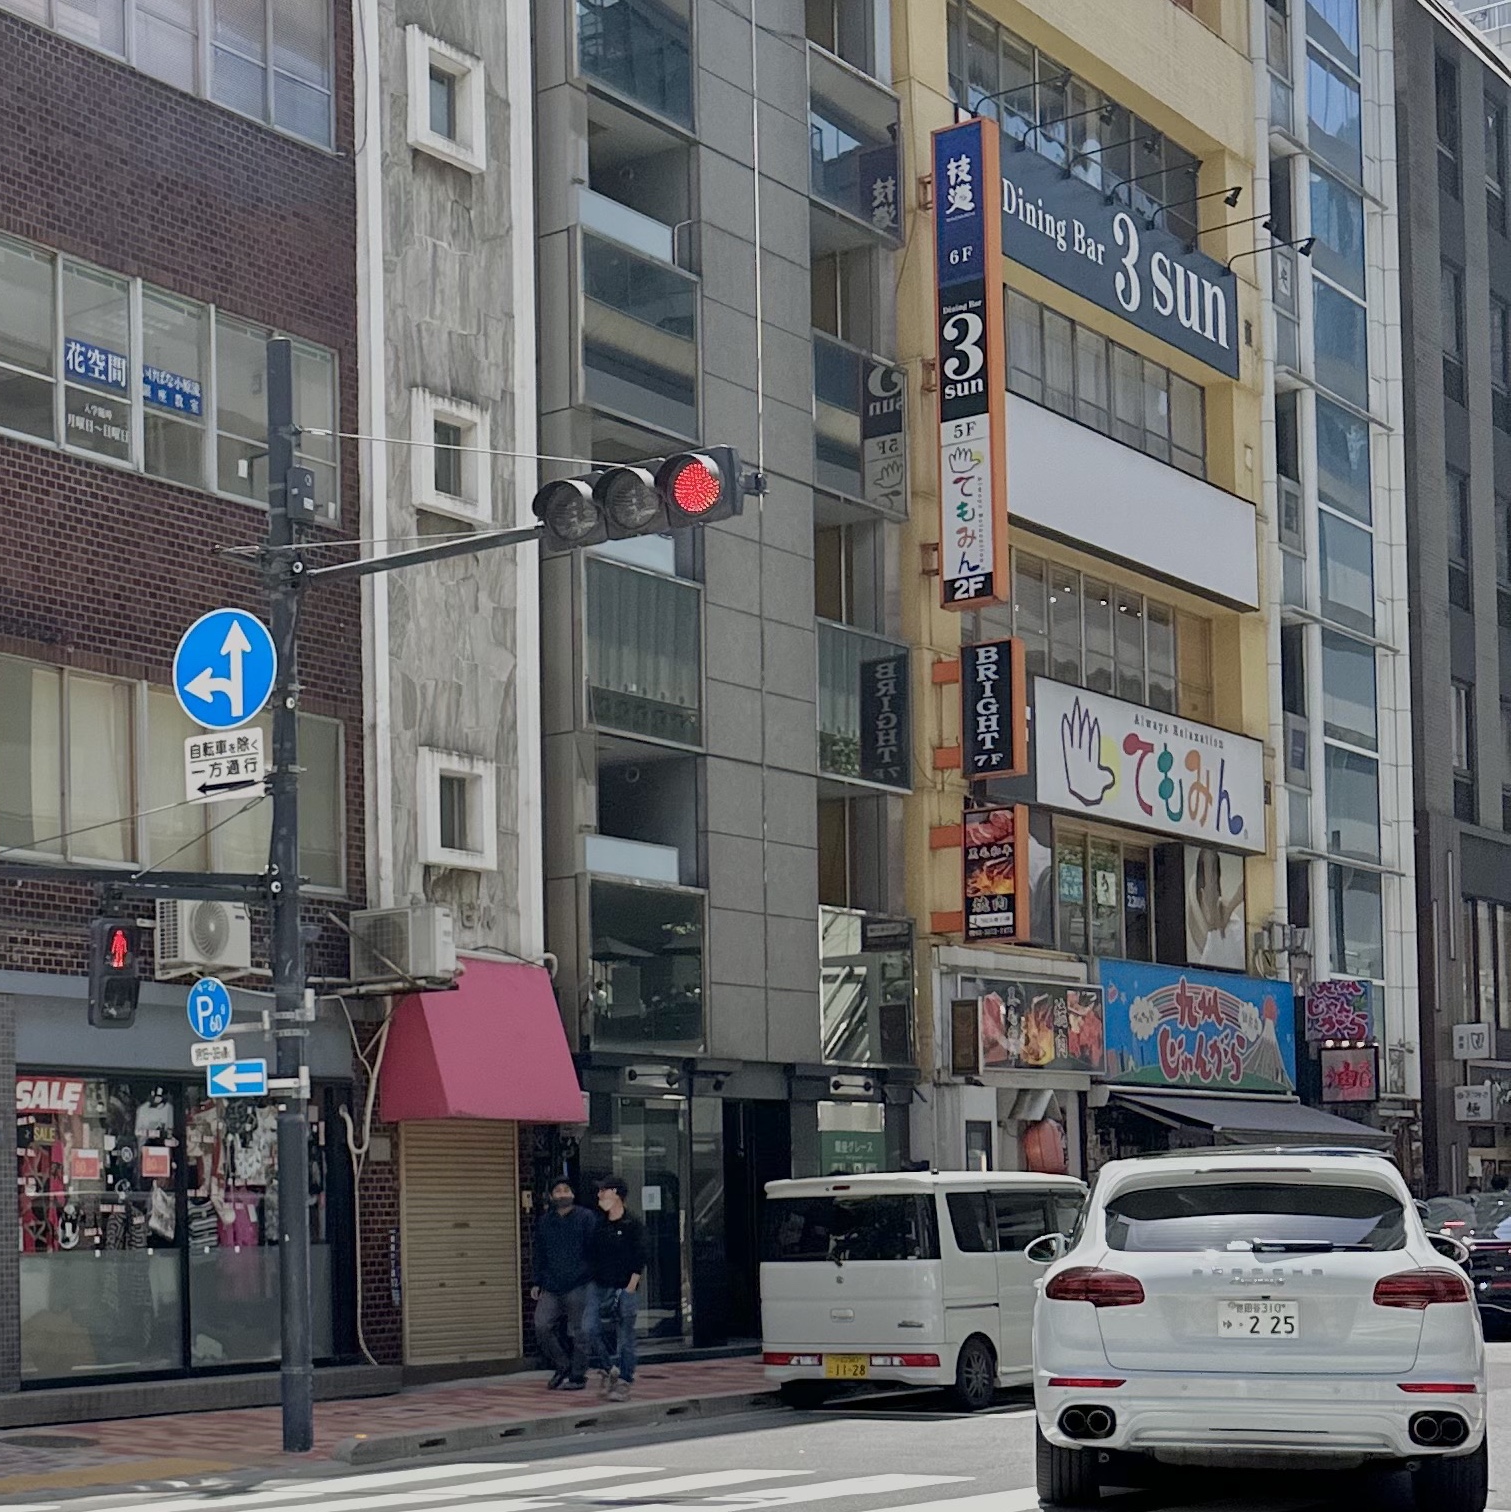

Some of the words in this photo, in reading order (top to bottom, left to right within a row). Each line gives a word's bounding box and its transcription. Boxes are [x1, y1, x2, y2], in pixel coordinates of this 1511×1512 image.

[949, 245, 974, 265] 6F
[1002, 177, 1066, 252] Dining
[1073, 219, 1105, 265] Bar
[1112, 212, 1141, 312] 3
[1151, 251, 1230, 350] sun
[943, 302, 968, 315] Dining
[969, 299, 982, 308] Bar
[943, 312, 984, 381] 3
[66, 341, 126, 387] 花空間
[944, 378, 984, 400] sun
[953, 421, 976, 439] 5F
[953, 475, 980, 575] てもみん
[954, 576, 985, 600] 2F
[975, 646, 999, 750] BRIGHT
[190, 736, 258, 759] 自転車を除く
[191, 757, 257, 778] 一方通行
[1123, 732, 1243, 836] てもみん
[16, 1081, 83, 1111] SALE
[33, 1126, 55, 1142] SALE
